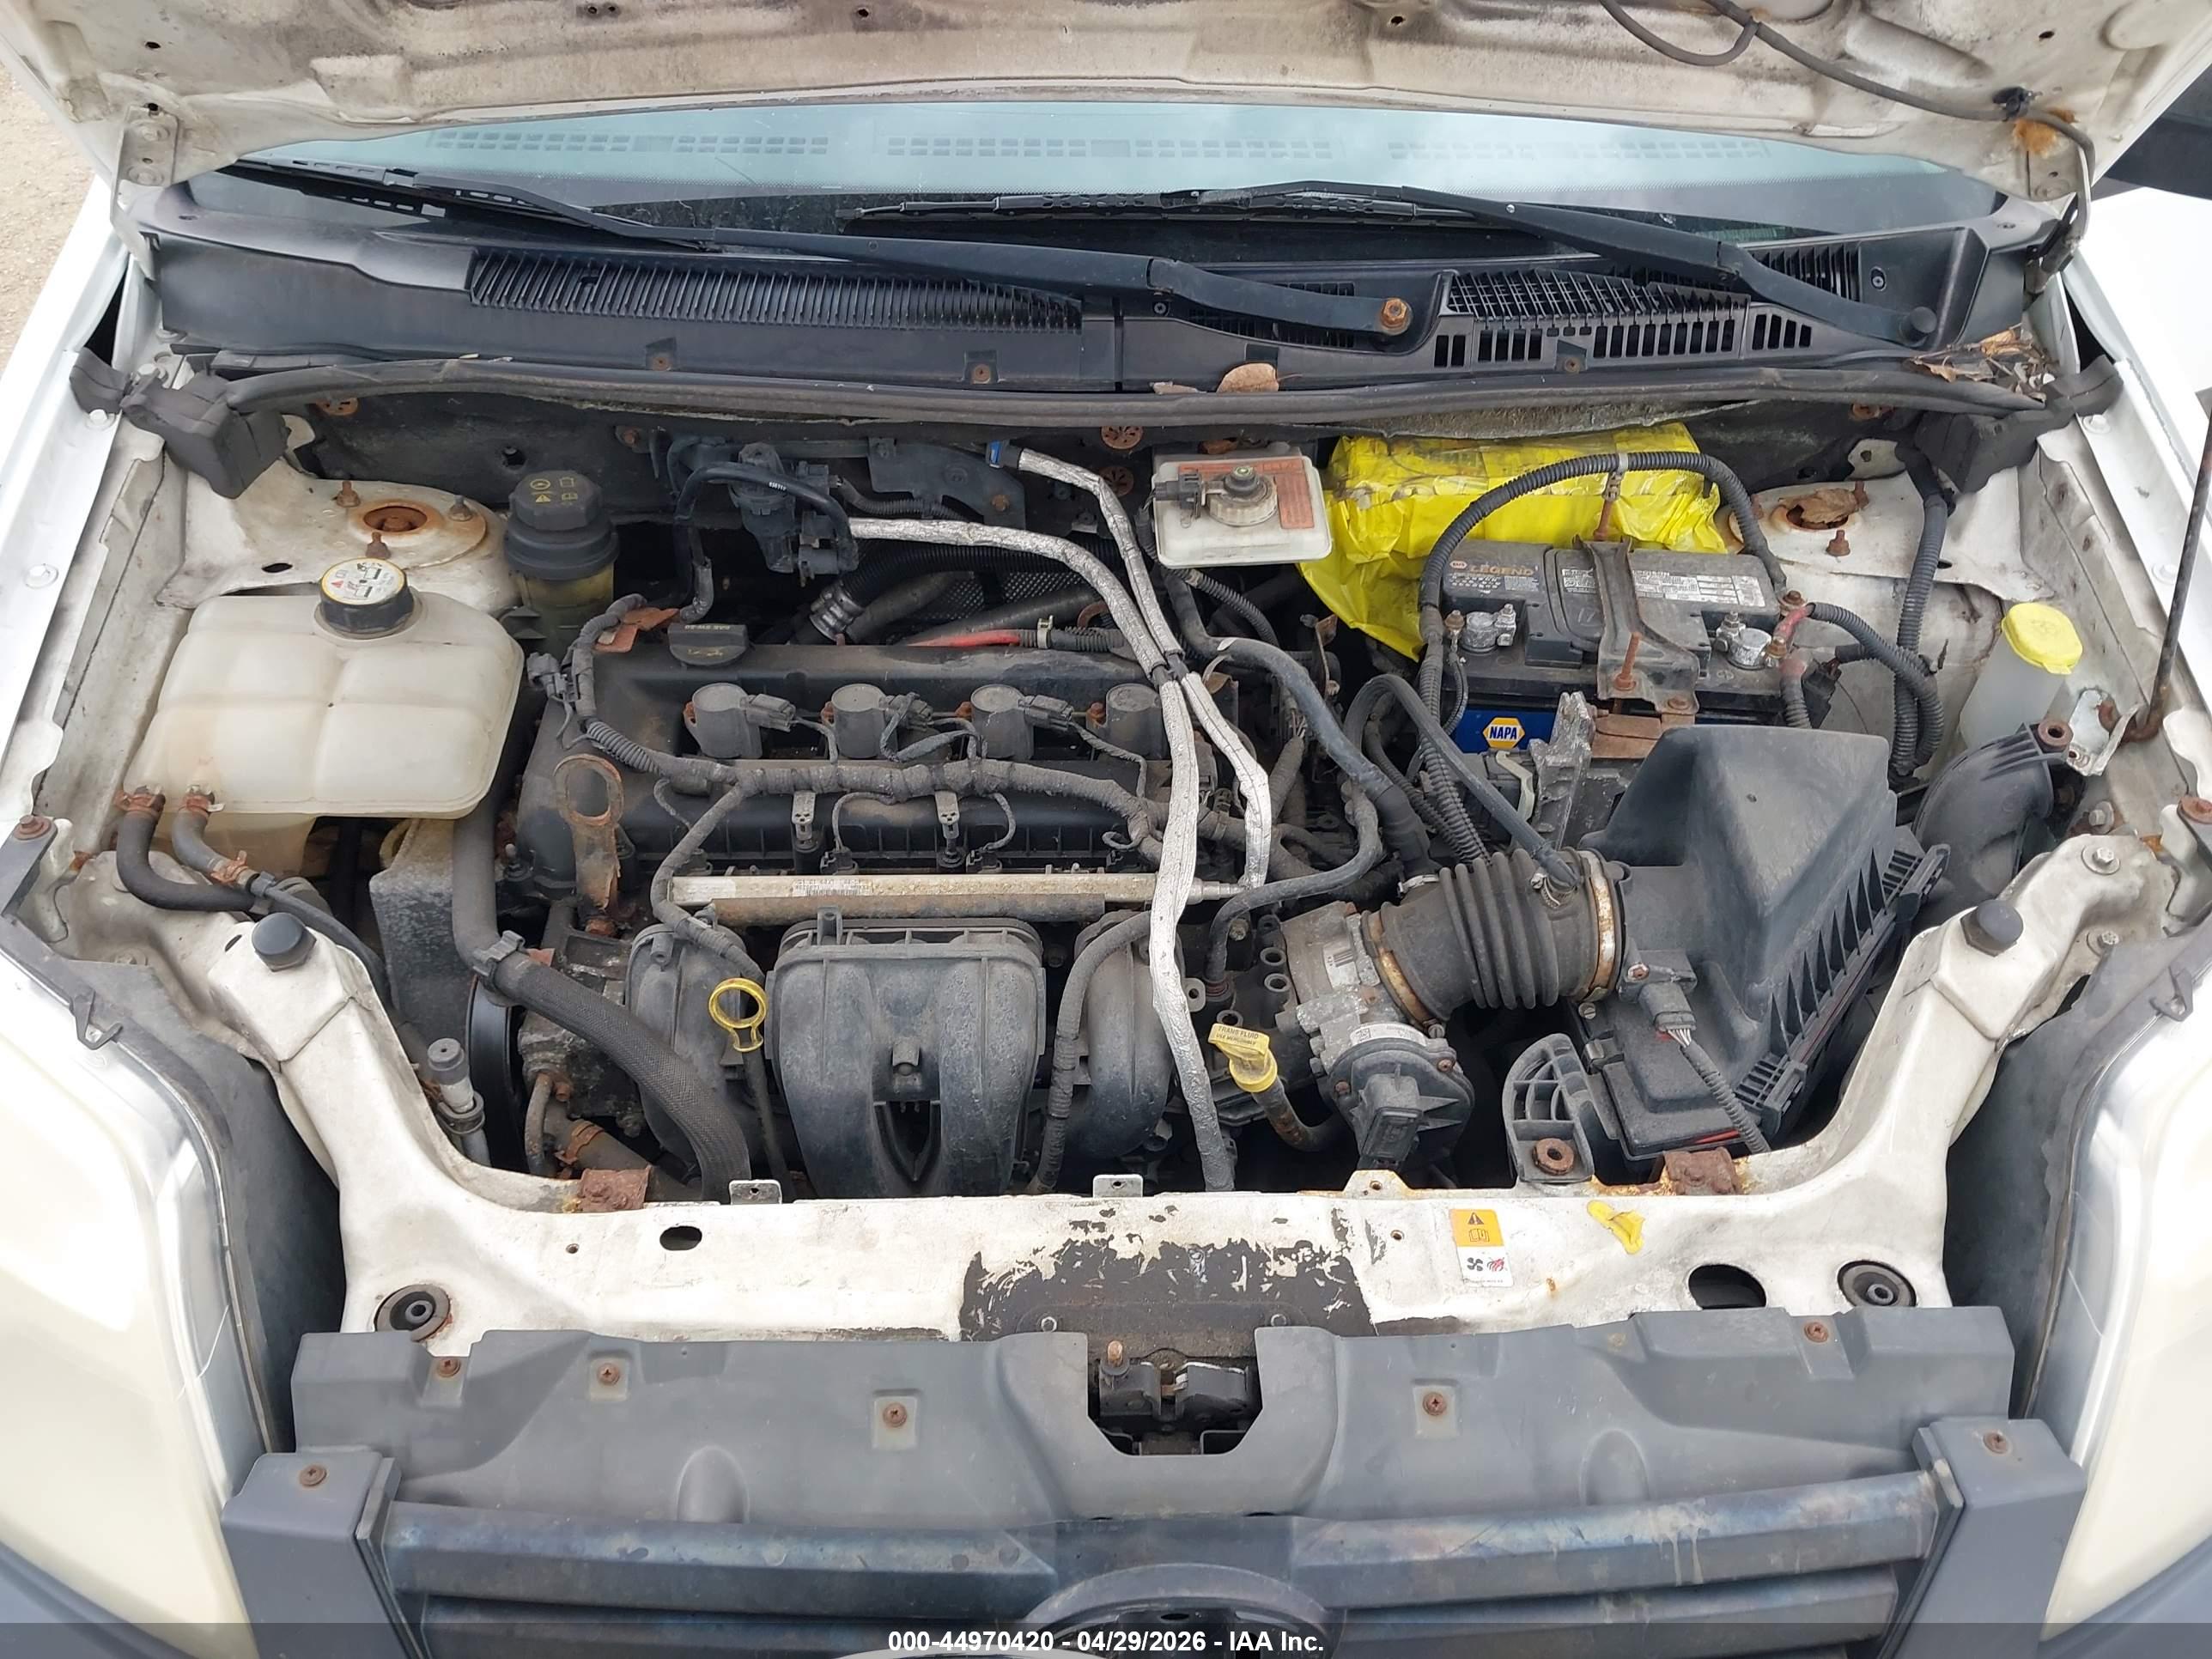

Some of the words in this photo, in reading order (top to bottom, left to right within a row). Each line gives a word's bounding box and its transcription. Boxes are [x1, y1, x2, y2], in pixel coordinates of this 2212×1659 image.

[1469, 565, 1534, 576] LEGEND
[1489, 726, 1517, 740] NAPA
[1218, 1025, 1239, 1035] TRANS
[1240, 1030, 1259, 1039] FLUID
